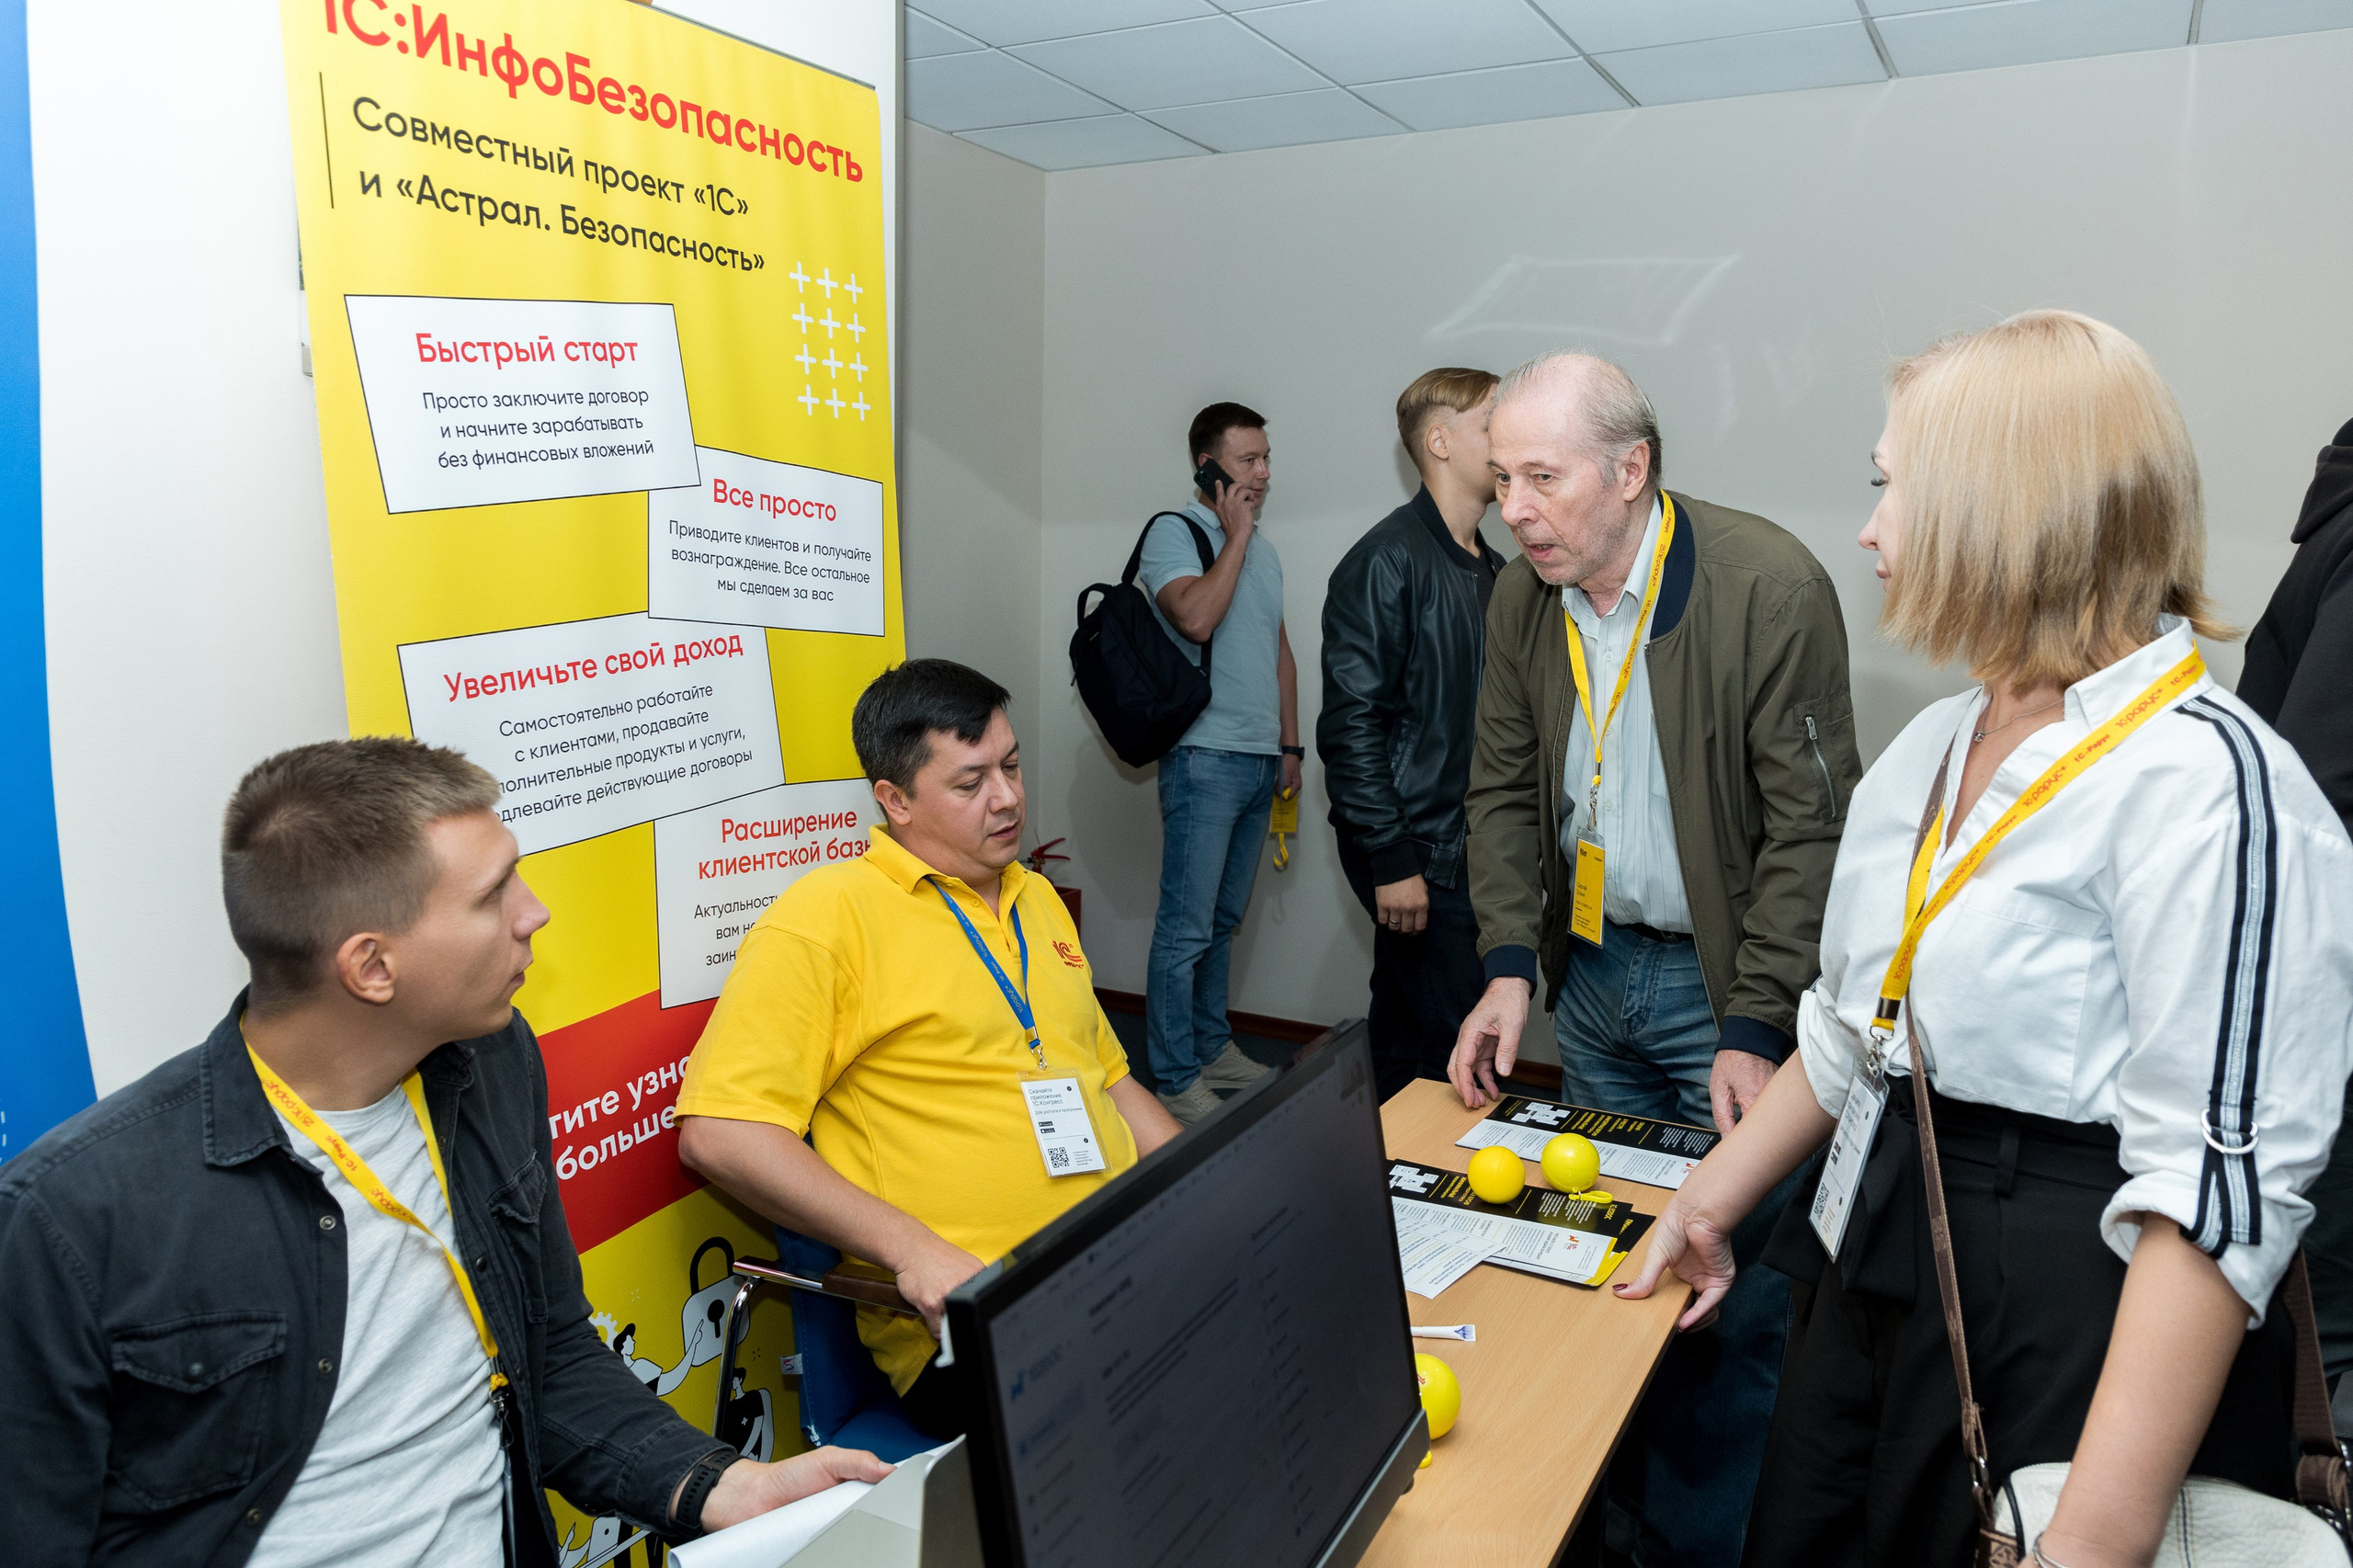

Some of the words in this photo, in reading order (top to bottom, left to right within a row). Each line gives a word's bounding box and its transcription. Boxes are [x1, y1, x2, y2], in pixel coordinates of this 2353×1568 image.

[324, 0, 864, 182] 1С:ИнфоБезопасность
[353, 96, 575, 176] Совместный
[583, 156, 685, 201] проект
[694, 183, 750, 218] «1С»
[359, 169, 383, 199] и
[396, 172, 551, 232] «Астрал.
[561, 203, 766, 272] Безопасность»
[415, 333, 555, 369] Быстрый
[563, 341, 638, 369] старт
[422, 392, 489, 414] Просто
[492, 390, 585, 409] заключите
[587, 388, 650, 406] договор
[440, 424, 451, 438] и
[456, 422, 529, 438] начните
[531, 416, 643, 437] зарабатывать
[438, 450, 469, 469] без
[472, 446, 580, 471] финансовых
[583, 439, 654, 460] вложений
[713, 478, 754, 508] Все
[759, 493, 837, 522] просто
[669, 519, 743, 544] Приводите
[745, 533, 800, 553] клиентов
[802, 542, 811, 553] и
[813, 544, 872, 562] получайте
[671, 548, 781, 574] вознаграждение.
[783, 561, 808, 576] Все
[811, 566, 870, 584] остальное
[717, 578, 736, 592] мы
[739, 580, 790, 598] сделаем
[792, 587, 808, 599] за
[812, 589, 835, 602] вас
[443, 657, 597, 702] Увеличьте
[604, 642, 665, 676] свой
[673, 634, 745, 668] доход
[498, 699, 633, 738] Самостоятельно
[636, 683, 714, 715] работайте
[514, 748, 526, 763] с
[529, 729, 620, 762] клиентами,
[622, 710, 710, 742] продавайте
[615, 740, 686, 770] продукты
[688, 739, 699, 751] и
[699, 727, 747, 753] услуги,
[496, 790, 583, 824] длевайте
[585, 767, 687, 803] действующие
[689, 749, 754, 778] договоры
[721, 810, 858, 843] Расширение
[698, 840, 821, 881] клиентской
[715, 925, 740, 940] вам
[705, 949, 738, 966] заин
[548, 1090, 620, 1140] тите
